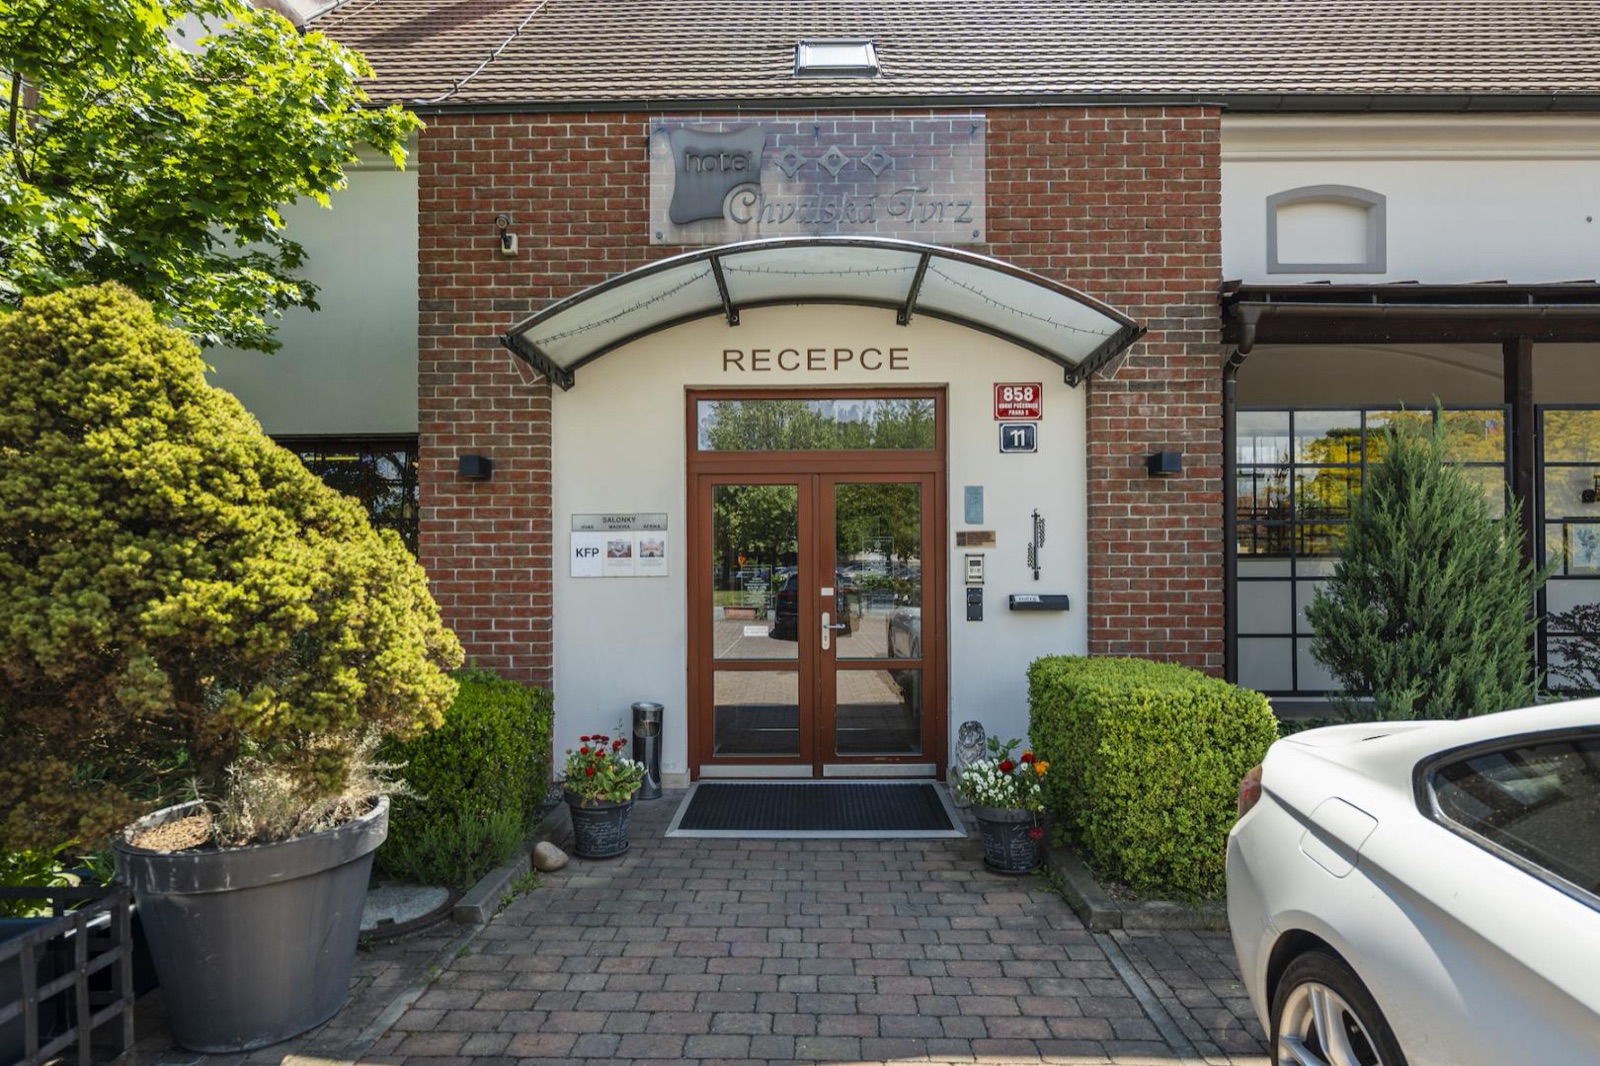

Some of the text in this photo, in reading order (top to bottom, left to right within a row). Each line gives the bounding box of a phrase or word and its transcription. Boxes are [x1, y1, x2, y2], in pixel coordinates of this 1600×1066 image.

[685, 150, 752, 172] hotel
[729, 186, 973, 224] Chvalská Tvrz
[722, 347, 909, 371] RECEPCE
[1003, 386, 1033, 401] 858
[1010, 429, 1025, 446] 11
[602, 516, 636, 524] SALONKY
[575, 547, 600, 558] KFP
